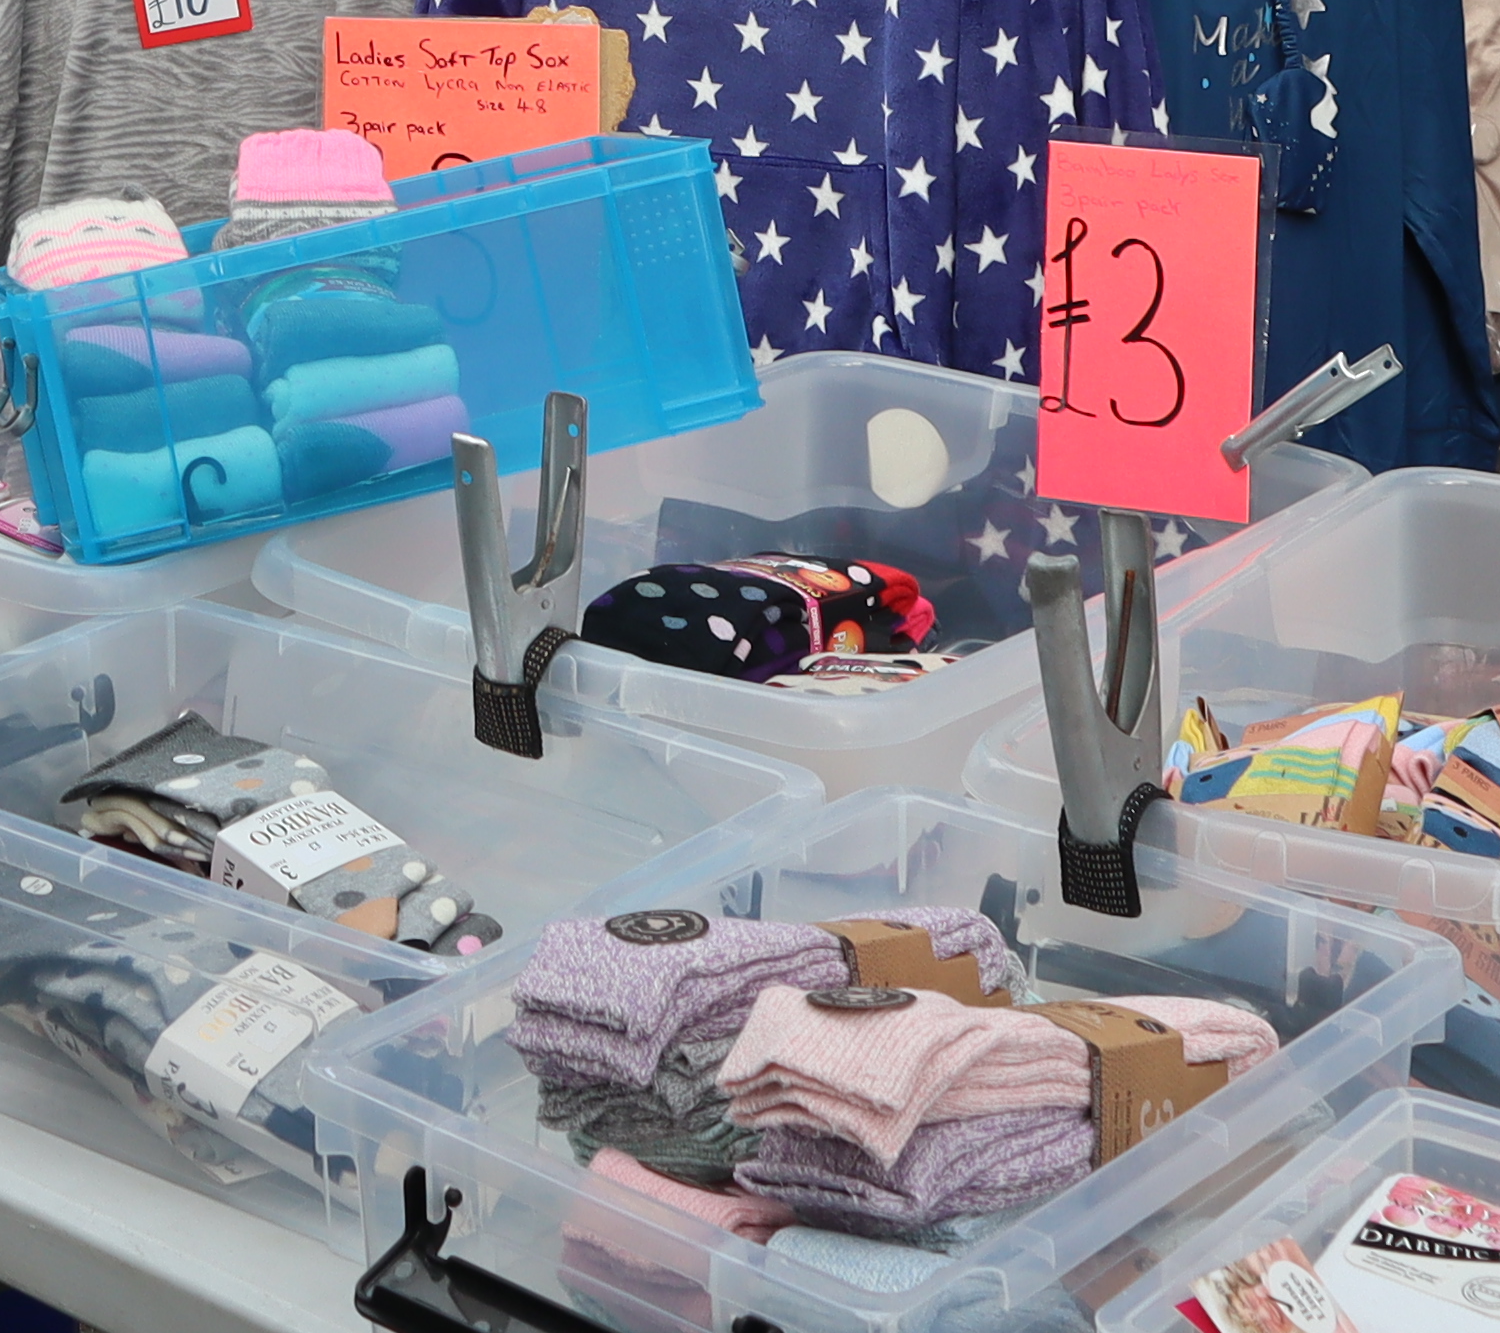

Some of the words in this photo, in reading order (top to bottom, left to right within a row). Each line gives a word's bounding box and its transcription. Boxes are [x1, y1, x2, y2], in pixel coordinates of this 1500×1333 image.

[336, 31, 405, 68] Ladies
[481, 45, 516, 77] Top
[529, 43, 570, 69] Sox
[406, 121, 448, 142] pack
[1137, 197, 1181, 226] pack
[1039, 216, 1186, 428] £3
[809, 664, 818, 673] 3
[822, 664, 878, 674] PACK
[1451, 762, 1459, 771] 3
[1459, 767, 1492, 793] PAIRS
[249, 801, 349, 846] BAMBOO
[279, 864, 299, 881] 3
[237, 1058, 259, 1077] 3
[1359, 1226, 1491, 1262] DIABETIC
